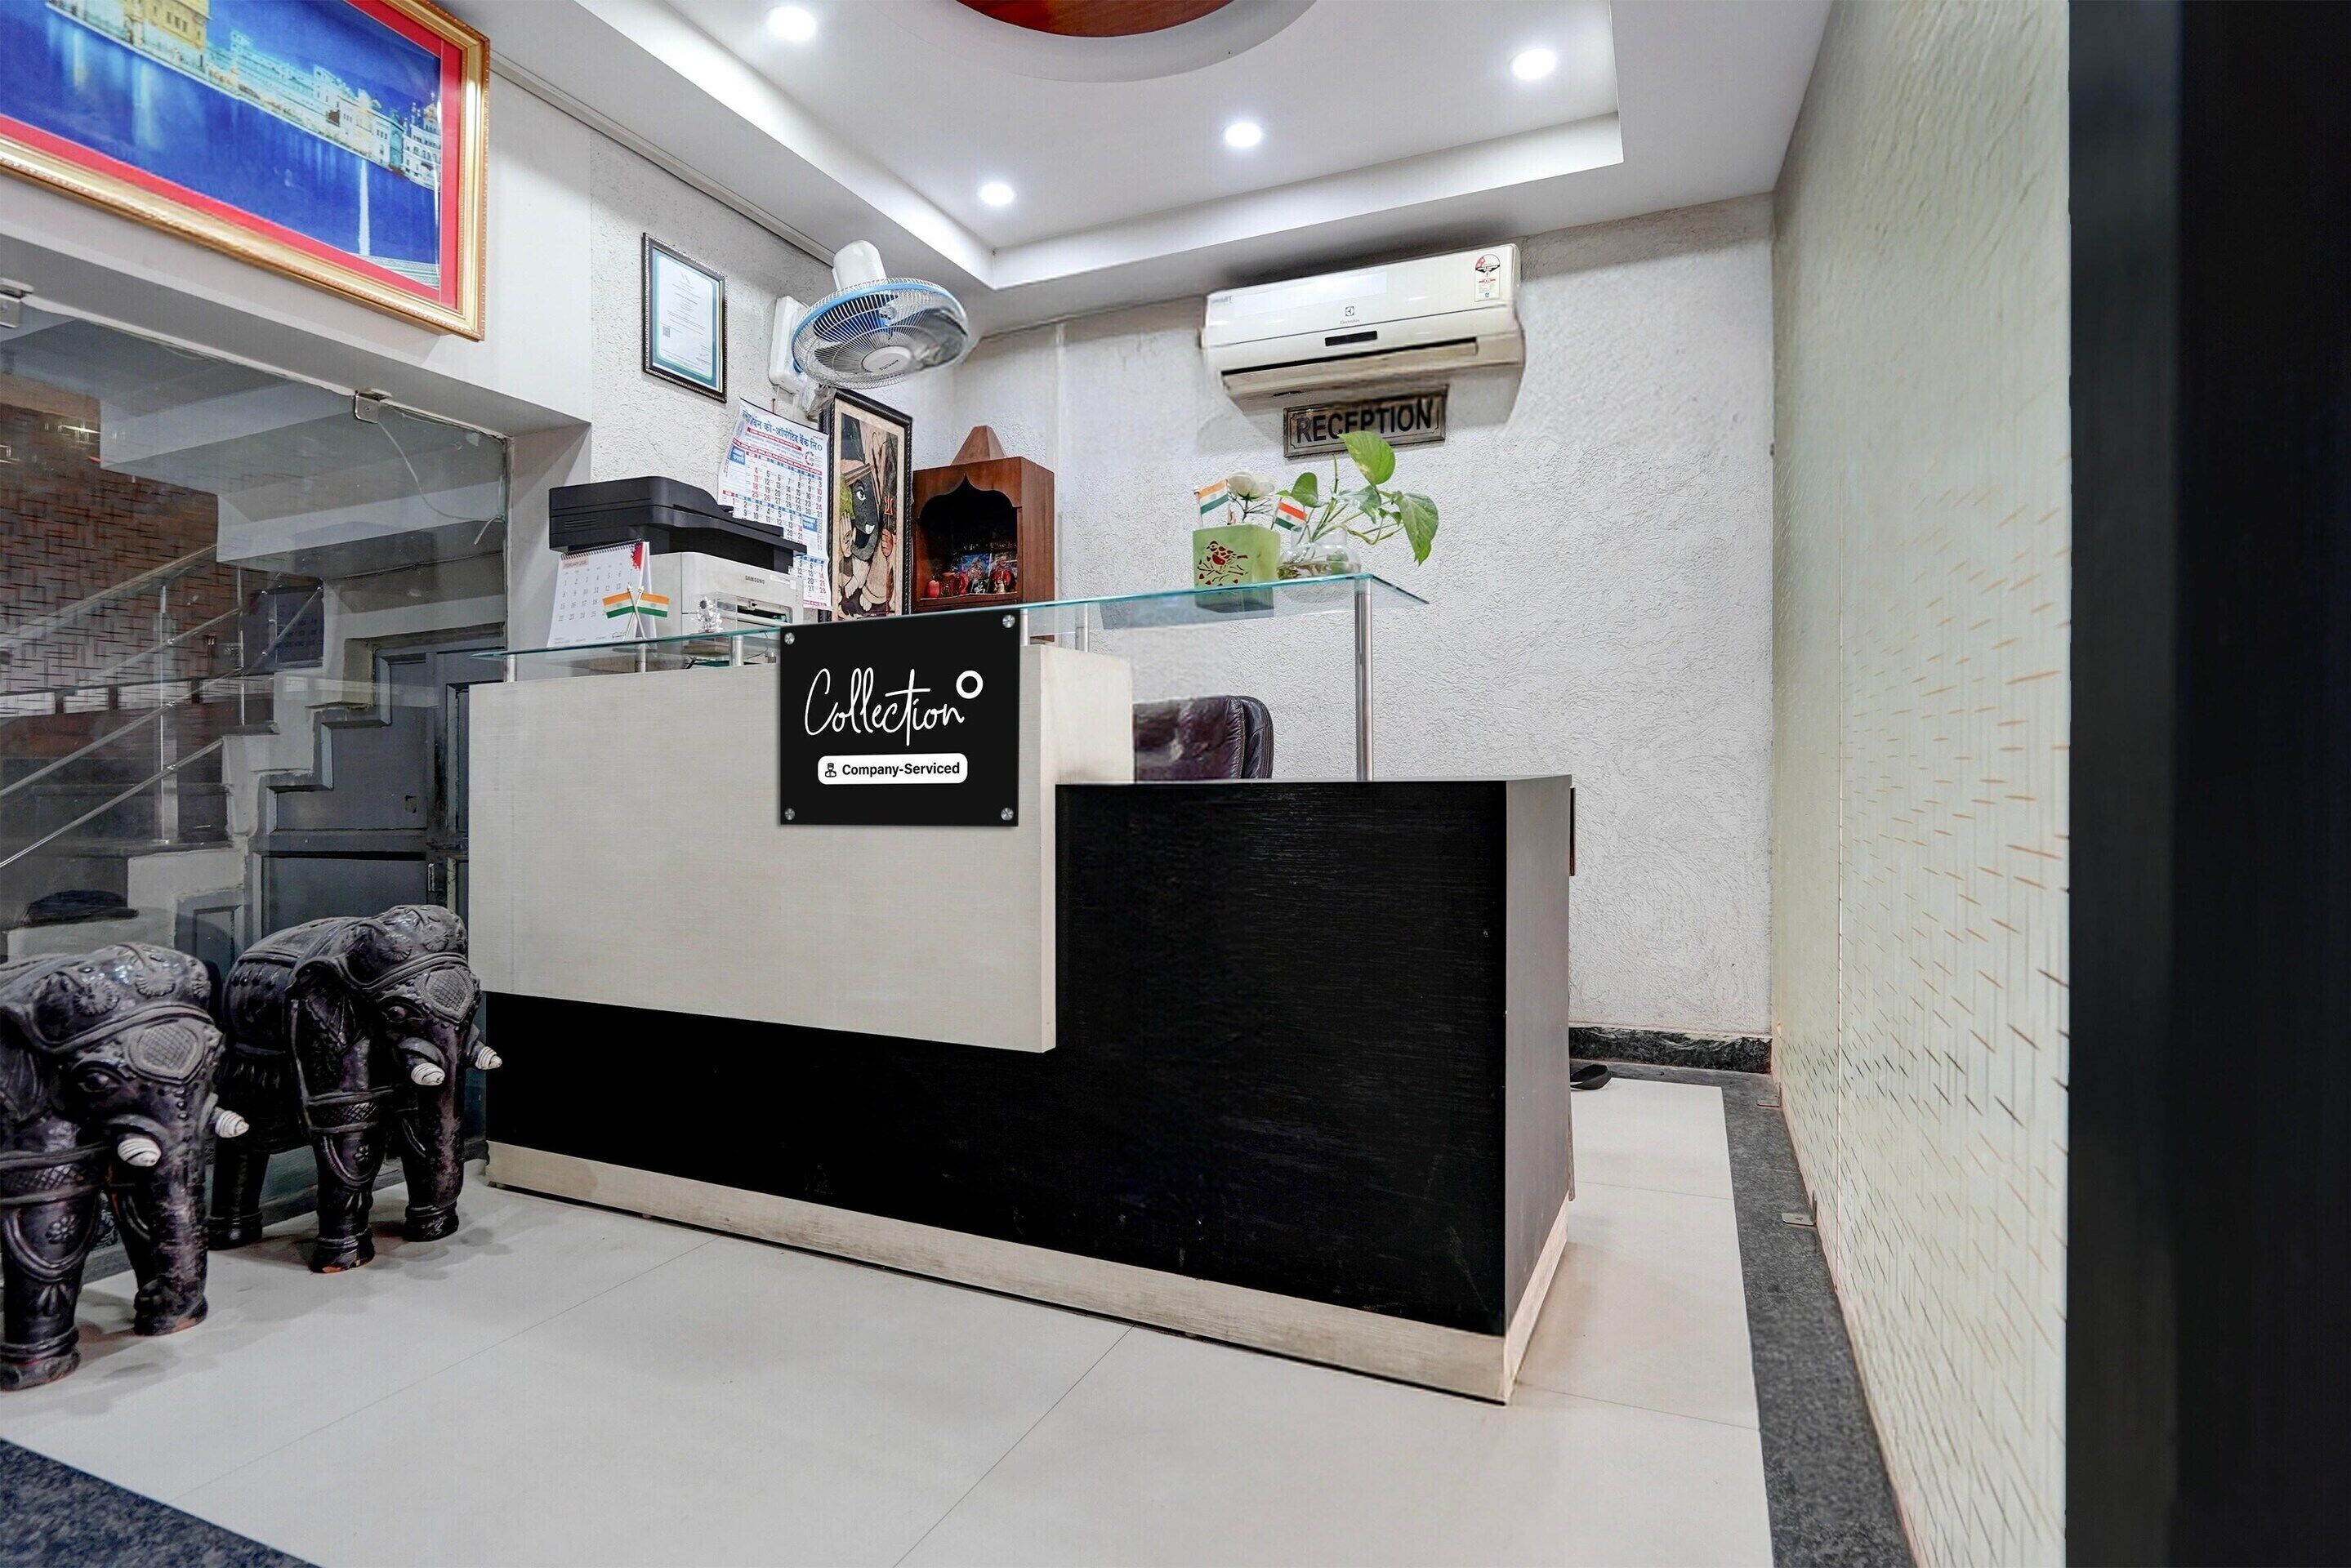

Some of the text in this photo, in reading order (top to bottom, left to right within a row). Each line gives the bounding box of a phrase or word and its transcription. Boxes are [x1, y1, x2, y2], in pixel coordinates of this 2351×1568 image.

[1296, 398, 1434, 443] RECEPTION
[745, 575, 765, 584] SAMSUNG
[804, 667, 965, 746] Collection
[842, 762, 960, 777] Company-Serviced
